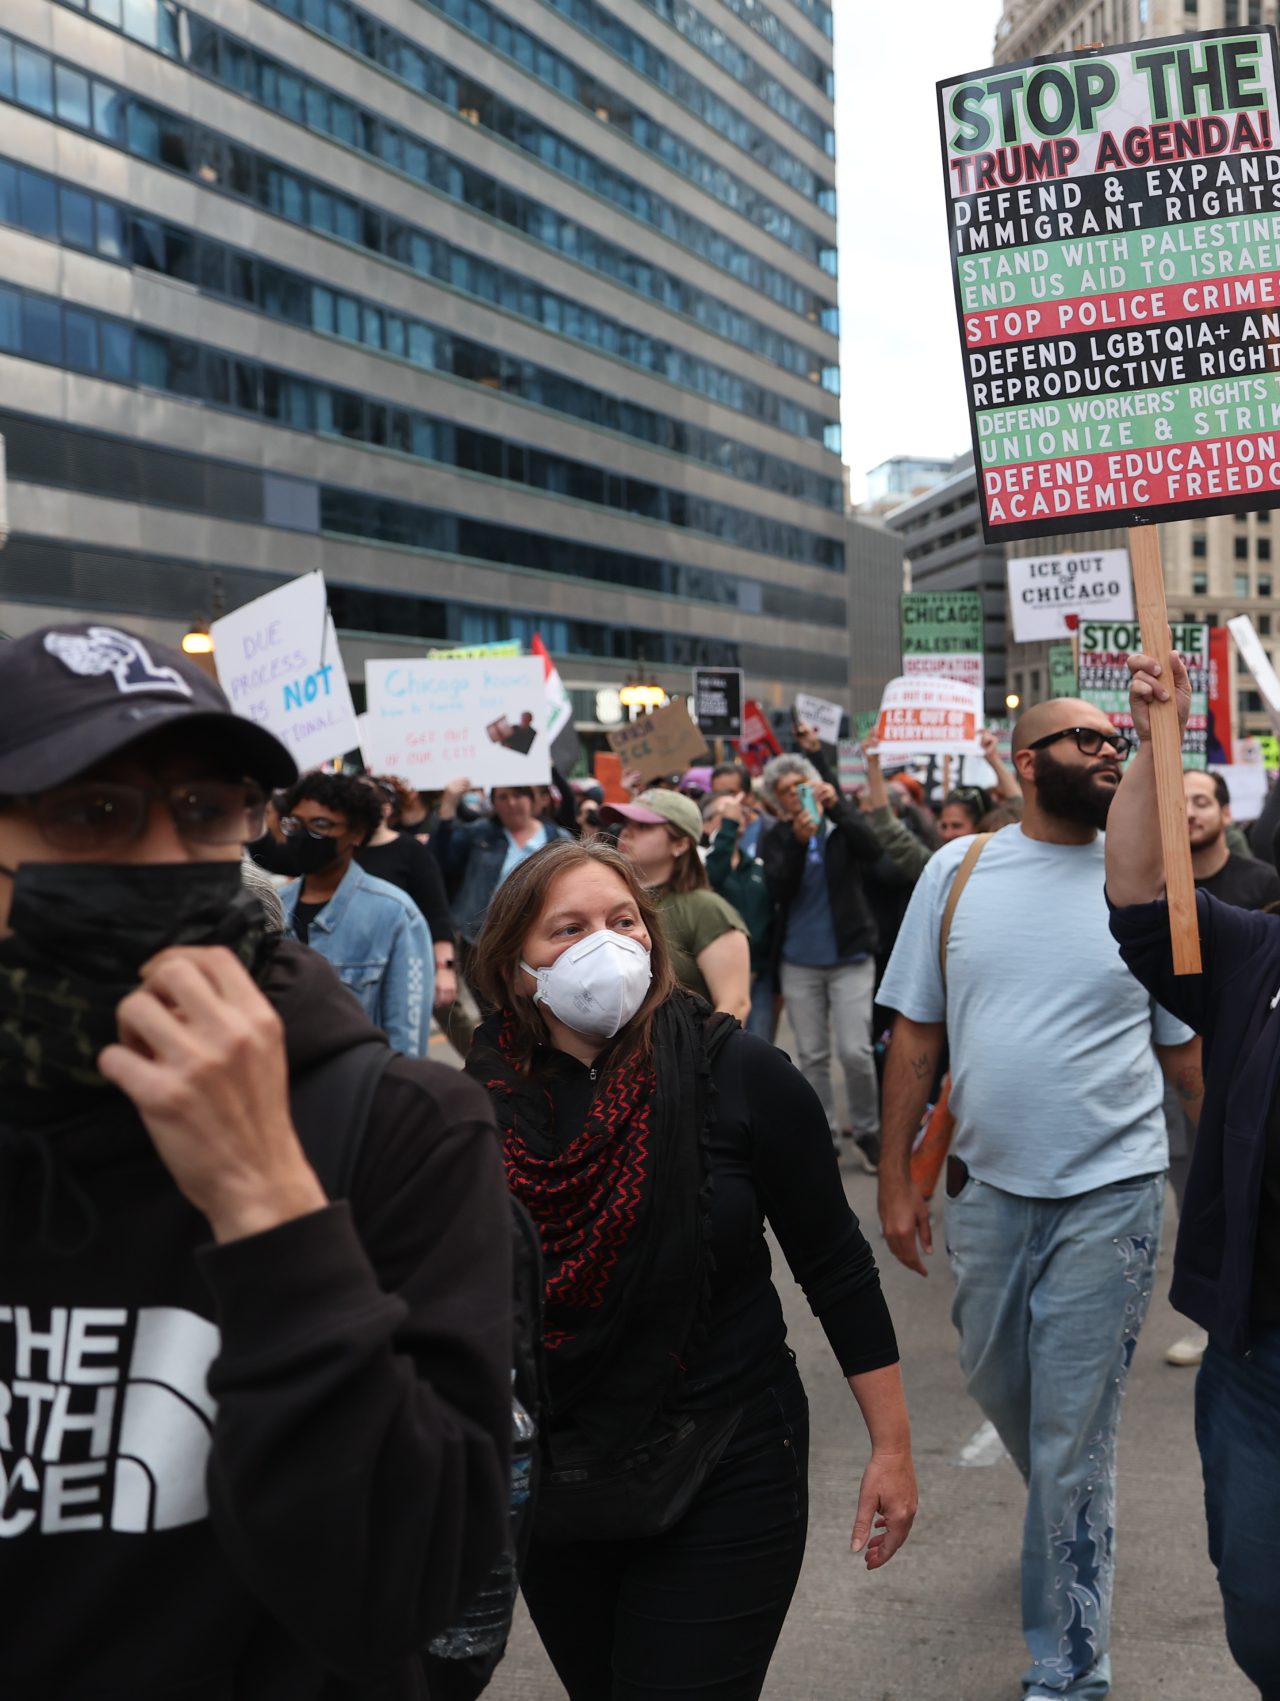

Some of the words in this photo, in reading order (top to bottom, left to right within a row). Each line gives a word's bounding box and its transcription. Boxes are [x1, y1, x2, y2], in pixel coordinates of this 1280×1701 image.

[950, 59, 1119, 154] STOP
[1131, 36, 1268, 123] THE
[950, 135, 1080, 196] TRUMP
[1094, 109, 1274, 174] AGENDA!
[954, 182, 1083, 227] DEFEND
[1104, 176, 1125, 203] &
[956, 202, 1144, 254] IMMIGRANT
[962, 250, 1049, 282] STAND
[1061, 237, 1129, 268] WITH
[965, 281, 1016, 310] END
[1030, 274, 1065, 298] US
[1080, 266, 1128, 292] AID
[1141, 259, 1176, 284] TO
[965, 309, 1042, 343] STOP
[1058, 292, 1167, 330] POLICE
[969, 340, 1077, 379] DEFEND
[1090, 323, 1231, 362] LGBTQIA+
[973, 356, 1186, 407] REPRODUCTIVE
[977, 406, 1061, 438] DEFEND
[1067, 389, 1181, 424] WORKERS'
[1188, 379, 1266, 410] RIGHTS
[981, 421, 1133, 463] UNIONIZE
[1154, 416, 1174, 441] &
[984, 459, 1094, 496] DEFEND
[1108, 436, 1277, 481] EDUCATION
[988, 478, 1150, 523] ACADEMIC
[1021, 581, 1121, 605] CHICAGO
[1029, 560, 1063, 579] ICE
[1067, 557, 1104, 575] OUT
[241, 619, 283, 662] DUE
[904, 605, 980, 625] CHICAGO
[1172, 625, 1203, 652] HE
[904, 636, 980, 652] PALESTINE
[229, 650, 309, 702] PROCESS
[282, 664, 334, 712] NOT
